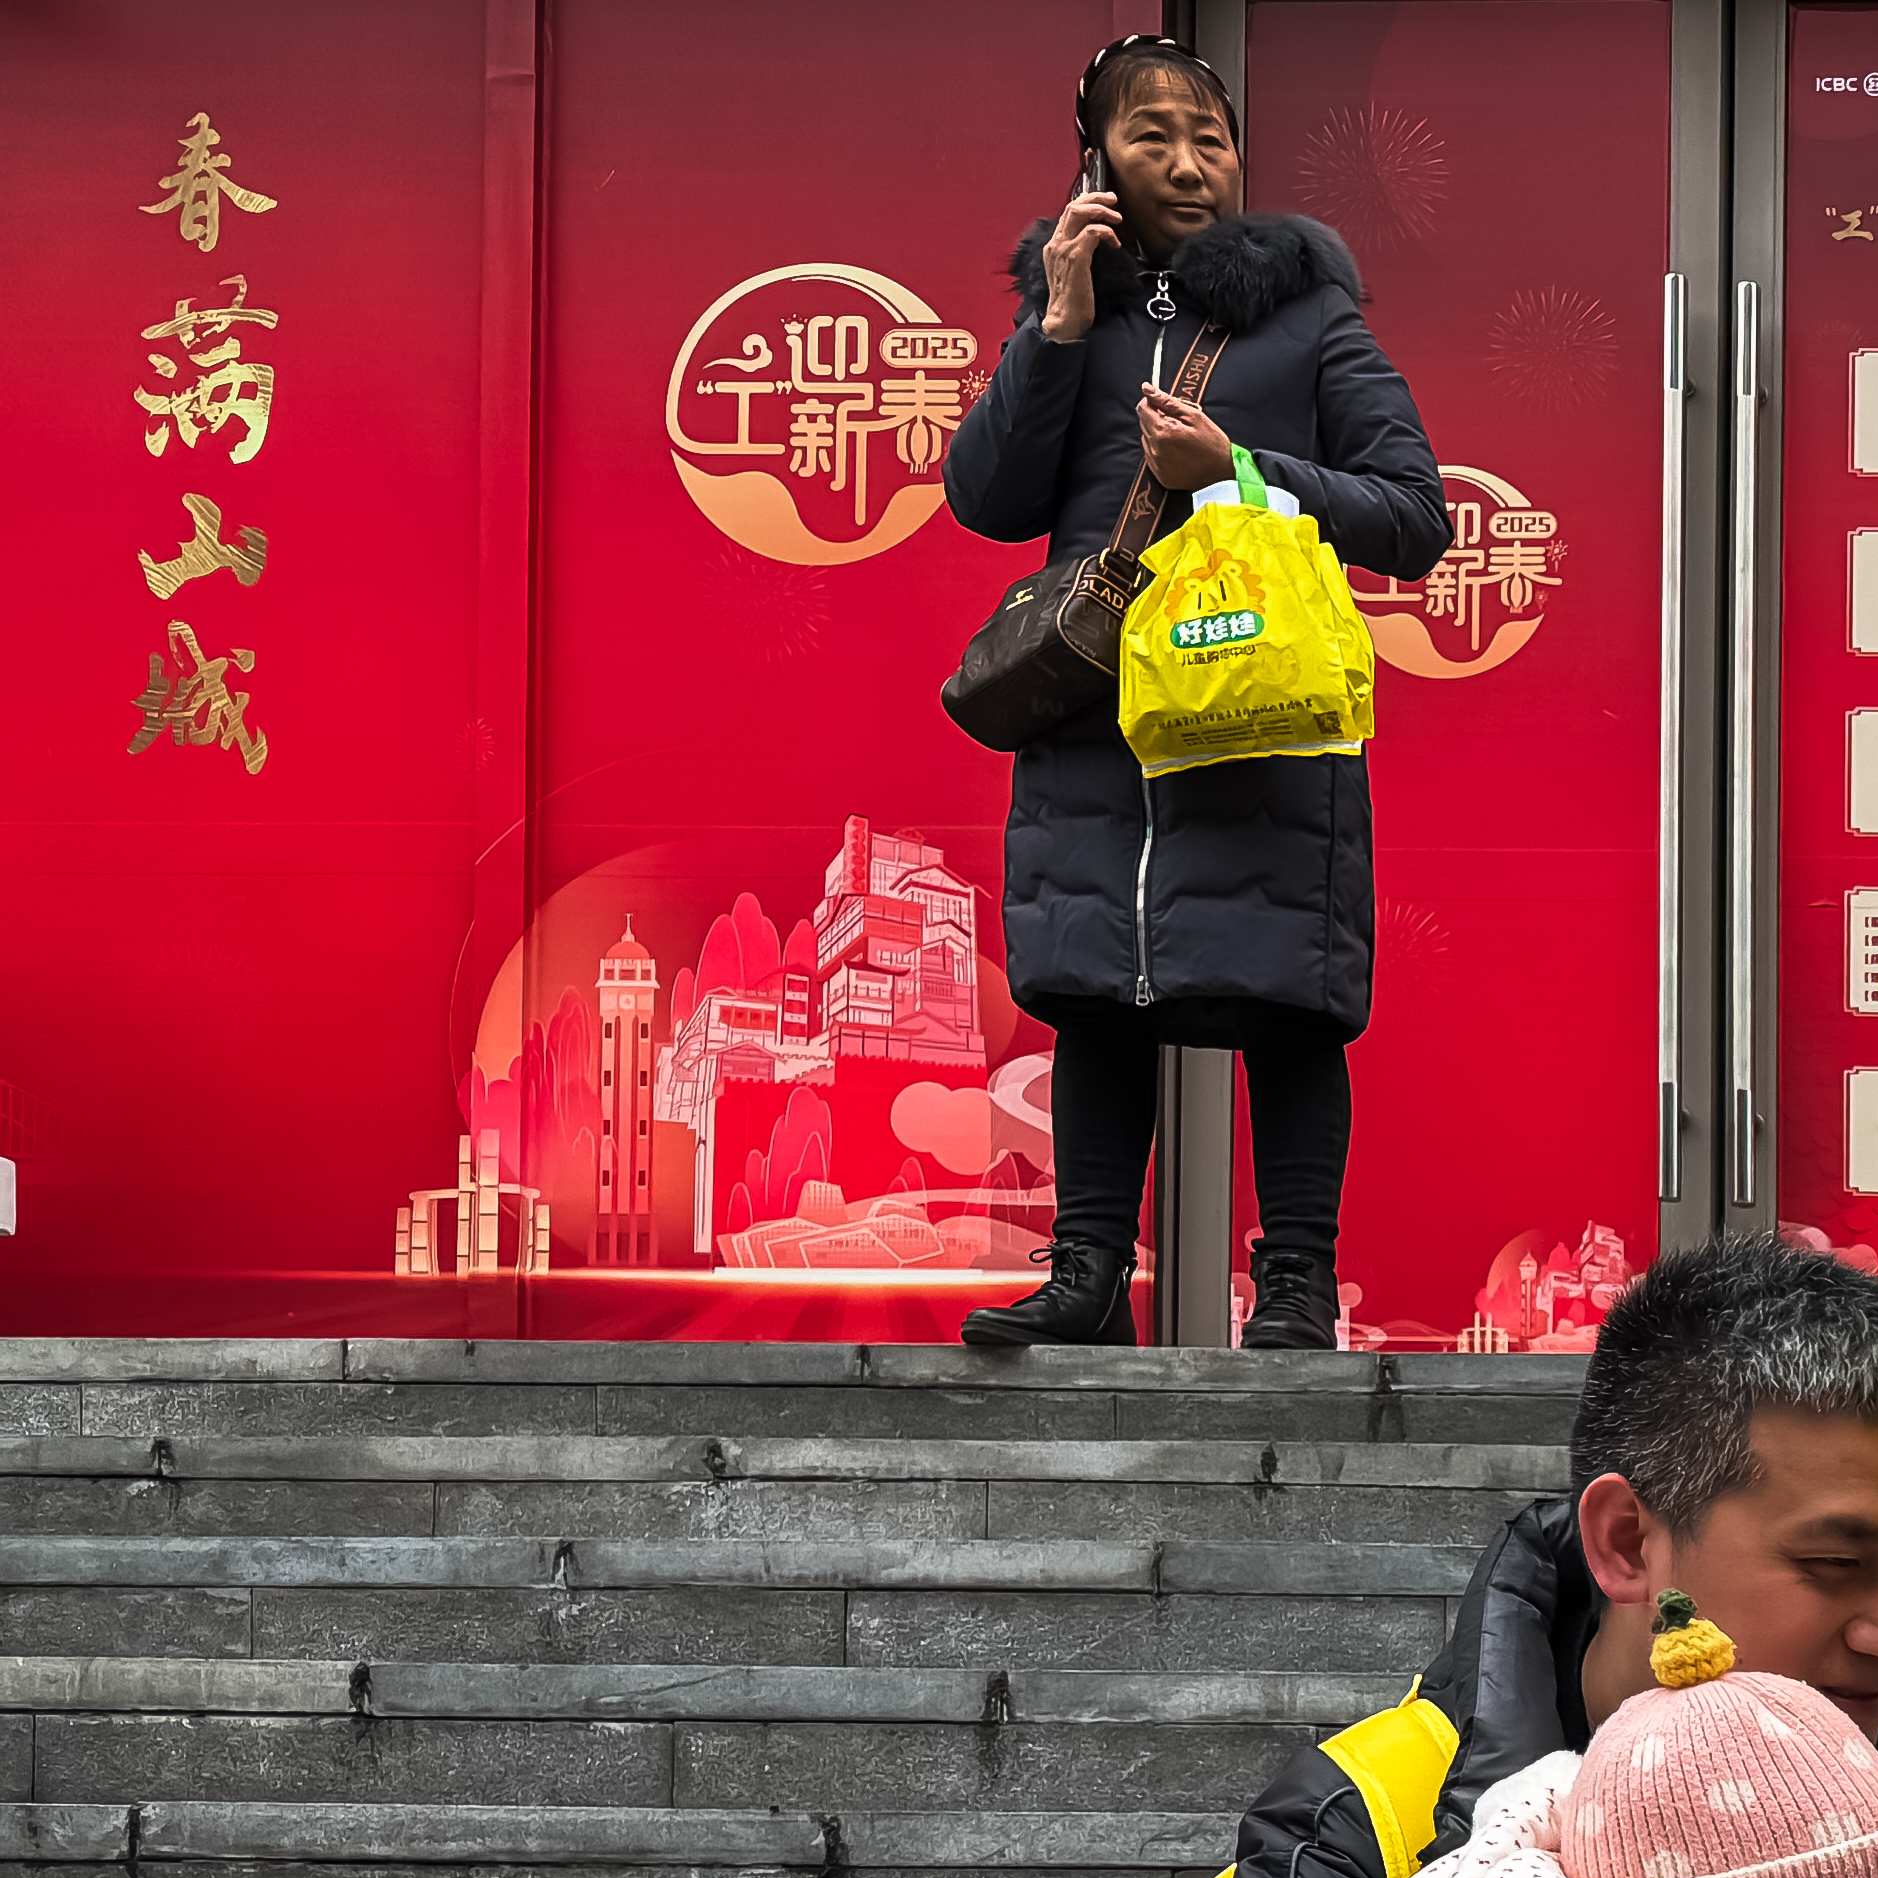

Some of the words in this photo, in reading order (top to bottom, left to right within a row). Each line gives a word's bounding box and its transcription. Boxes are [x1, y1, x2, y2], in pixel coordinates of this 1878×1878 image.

[1816, 77, 1858, 93] ICBC
[890, 335, 969, 359] 2025
[1181, 353, 1209, 401] AISHU
[138, 112, 279, 775] 春满山城
[1495, 516, 1551, 533] 2025
